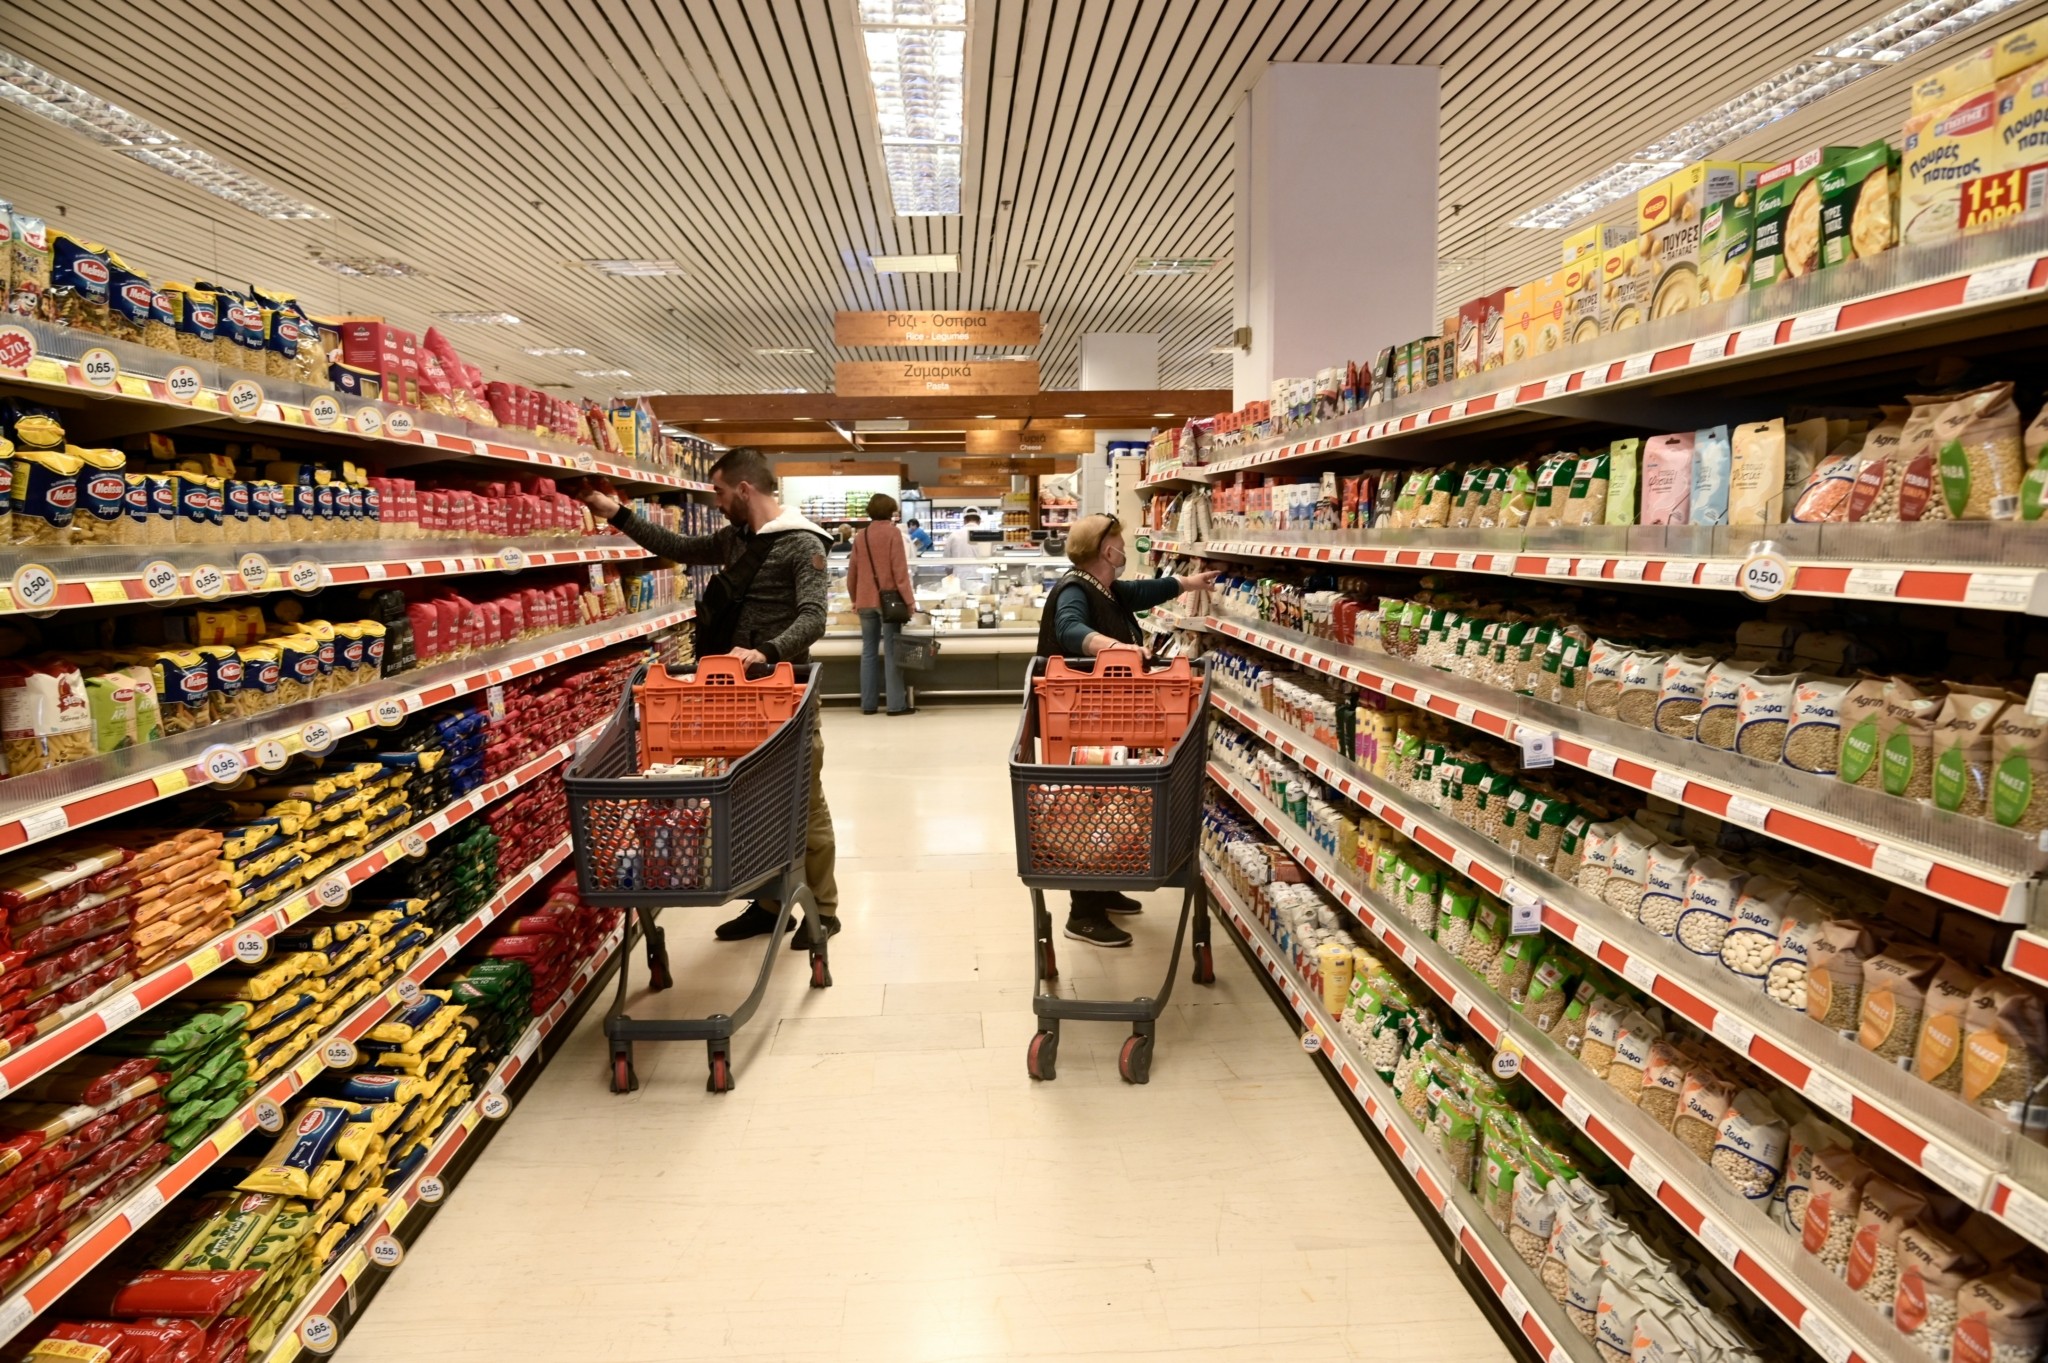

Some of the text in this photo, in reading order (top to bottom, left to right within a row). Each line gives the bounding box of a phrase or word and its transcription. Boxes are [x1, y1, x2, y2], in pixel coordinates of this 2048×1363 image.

[1968, 169, 2022, 211] 1+1
[1663, 224, 1699, 254] ΠΟΥΡΕΣ
[887, 314, 917, 328] Ρύζι
[931, 313, 987, 328] Όσπρια
[906, 332, 923, 341] Rice
[931, 332, 969, 342] Legumes
[904, 364, 971, 379] Ζυμαρικά
[926, 382, 949, 391] Pasta
[1018, 433, 1047, 445] Τυριά
[1873, 433, 1900, 448] Agrin
[1852, 694, 1884, 709] Agrin
[1936, 980, 1971, 997] Agrin
[1723, 1125, 1751, 1150] 3αλφα
